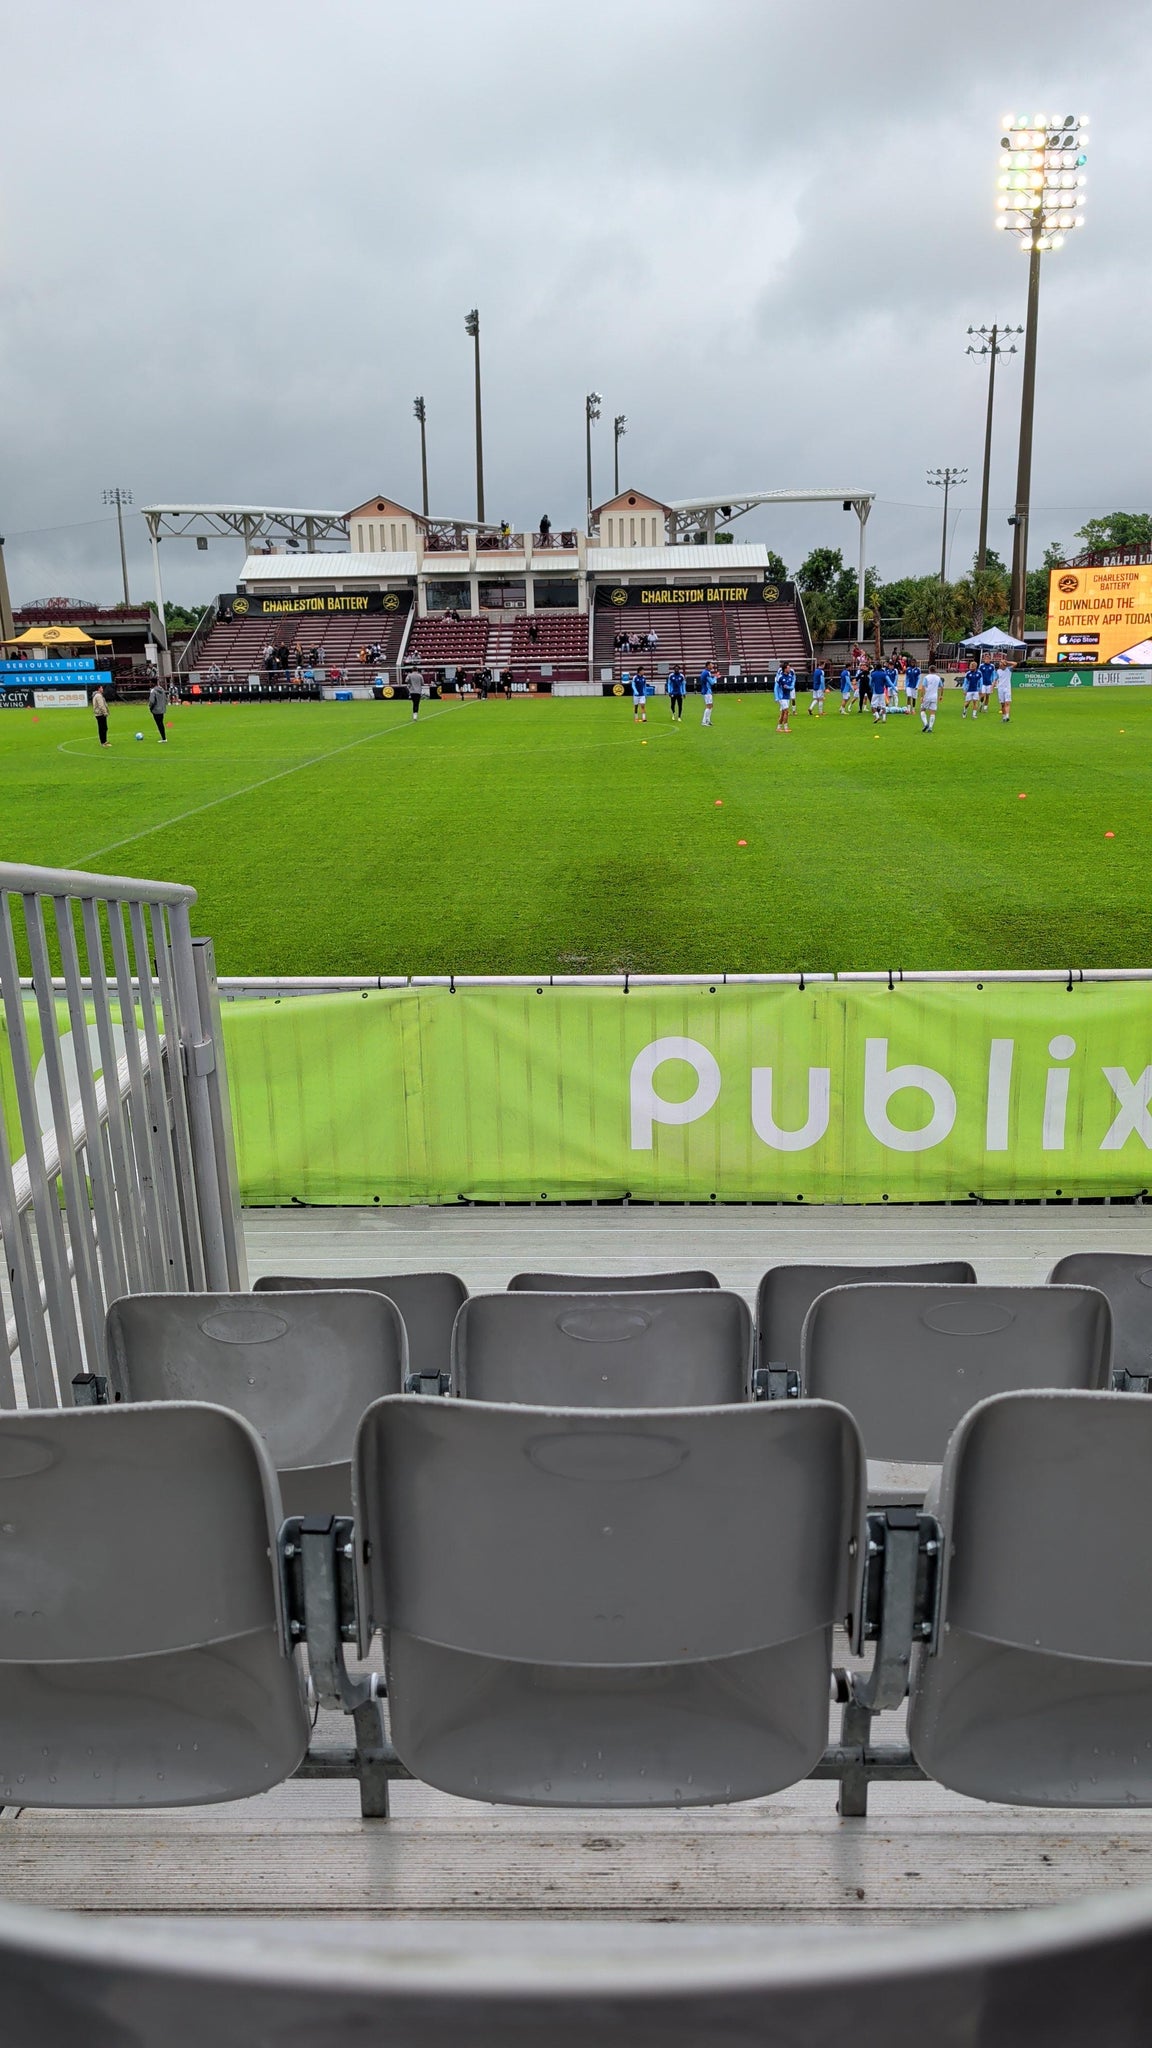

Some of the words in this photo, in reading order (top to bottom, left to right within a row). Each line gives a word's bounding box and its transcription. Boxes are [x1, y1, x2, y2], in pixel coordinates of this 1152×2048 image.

[1103, 554, 1136, 566] RALPH
[1093, 573, 1139, 582] CHARLESTON
[1100, 582, 1131, 591] BATTERY
[641, 588, 704, 604] CHARLESTON
[707, 587, 749, 602] BATTERY
[262, 598, 325, 613] CHARLESTON
[328, 596, 369, 611] BATTERY
[1059, 597, 1114, 611] DOWNLOAD
[1116, 597, 1135, 609] THE
[1058, 614, 1100, 626] BATTERY
[1102, 613, 1122, 625] APP
[6, 661, 60, 669] SERIOUSLY
[511, 683, 530, 692] USL
[8, 692, 28, 701] CITY
[36, 694, 55, 702] the
[58, 694, 86, 704] pass
[629, 1034, 1152, 1153] Publix
